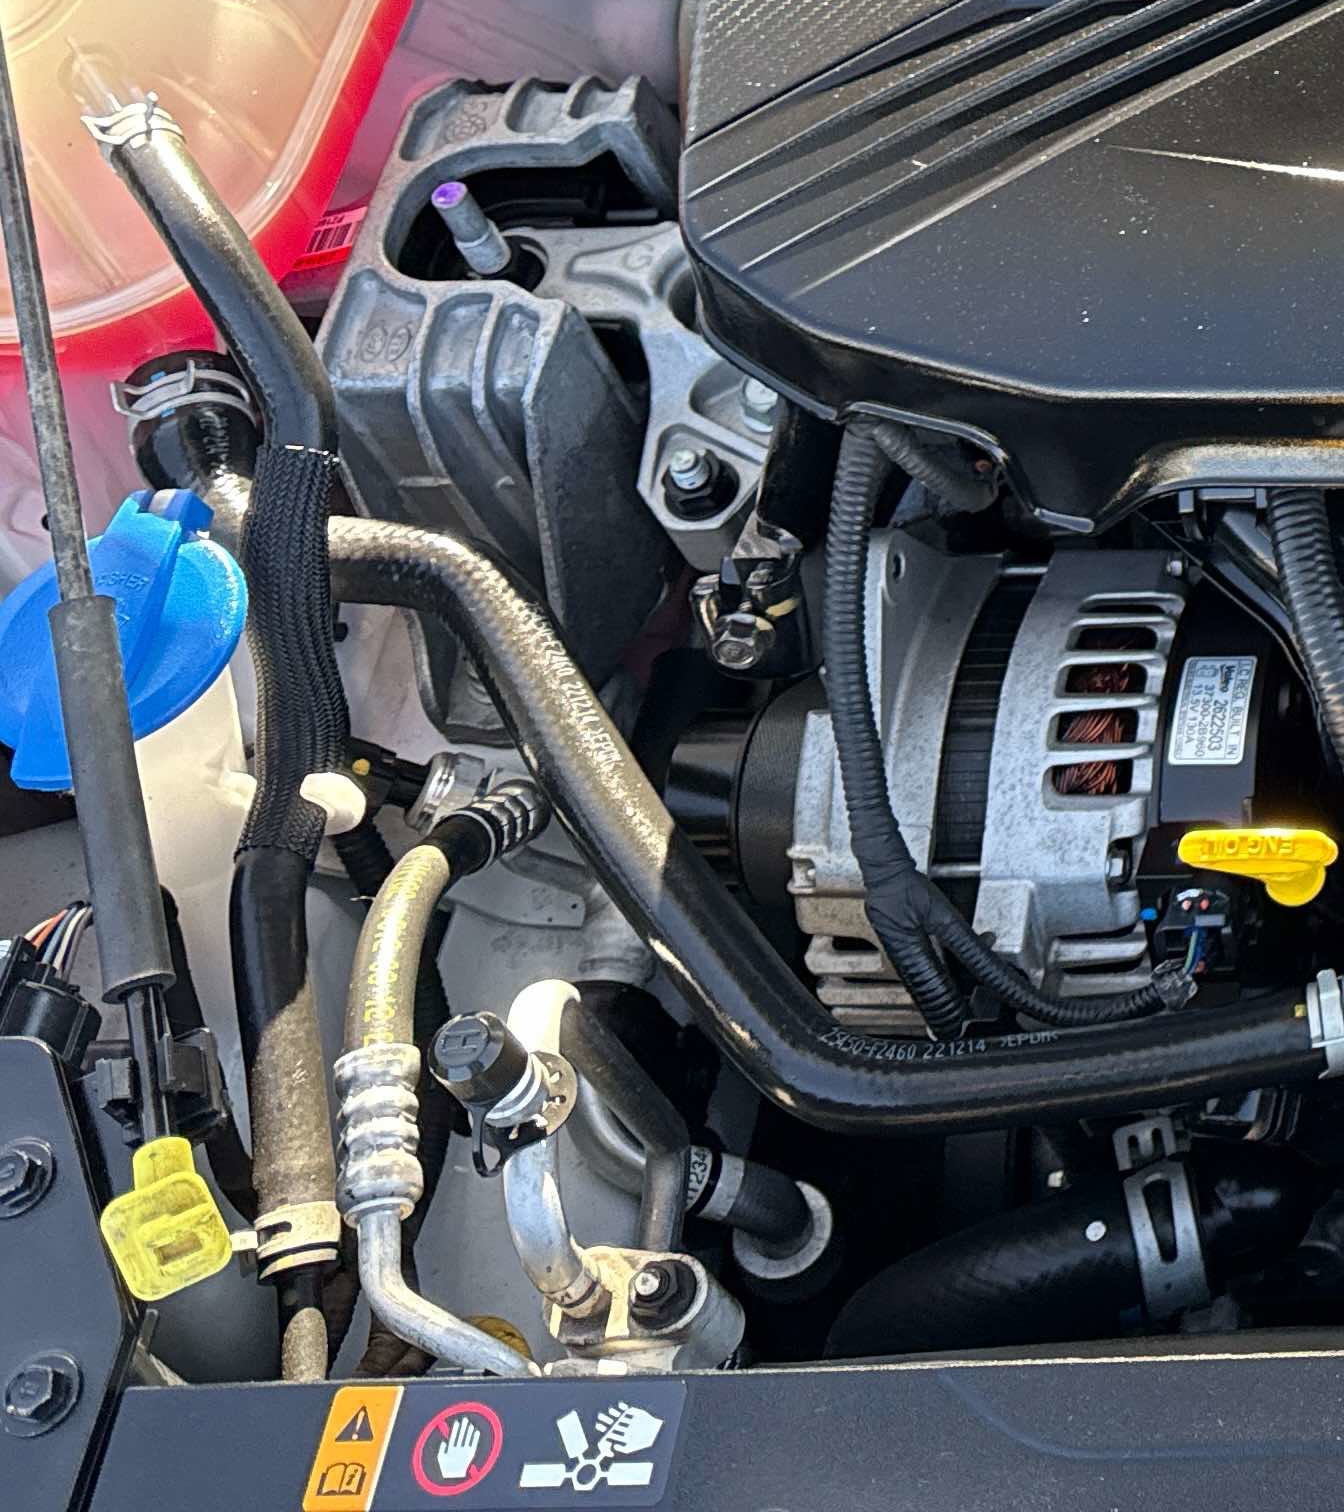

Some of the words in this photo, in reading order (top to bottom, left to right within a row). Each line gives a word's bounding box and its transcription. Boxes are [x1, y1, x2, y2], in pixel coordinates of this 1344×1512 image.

[1208, 699, 1229, 752] 2622503
[1248, 835, 1296, 855] ENG
[922, 1039, 987, 1061] 221214
